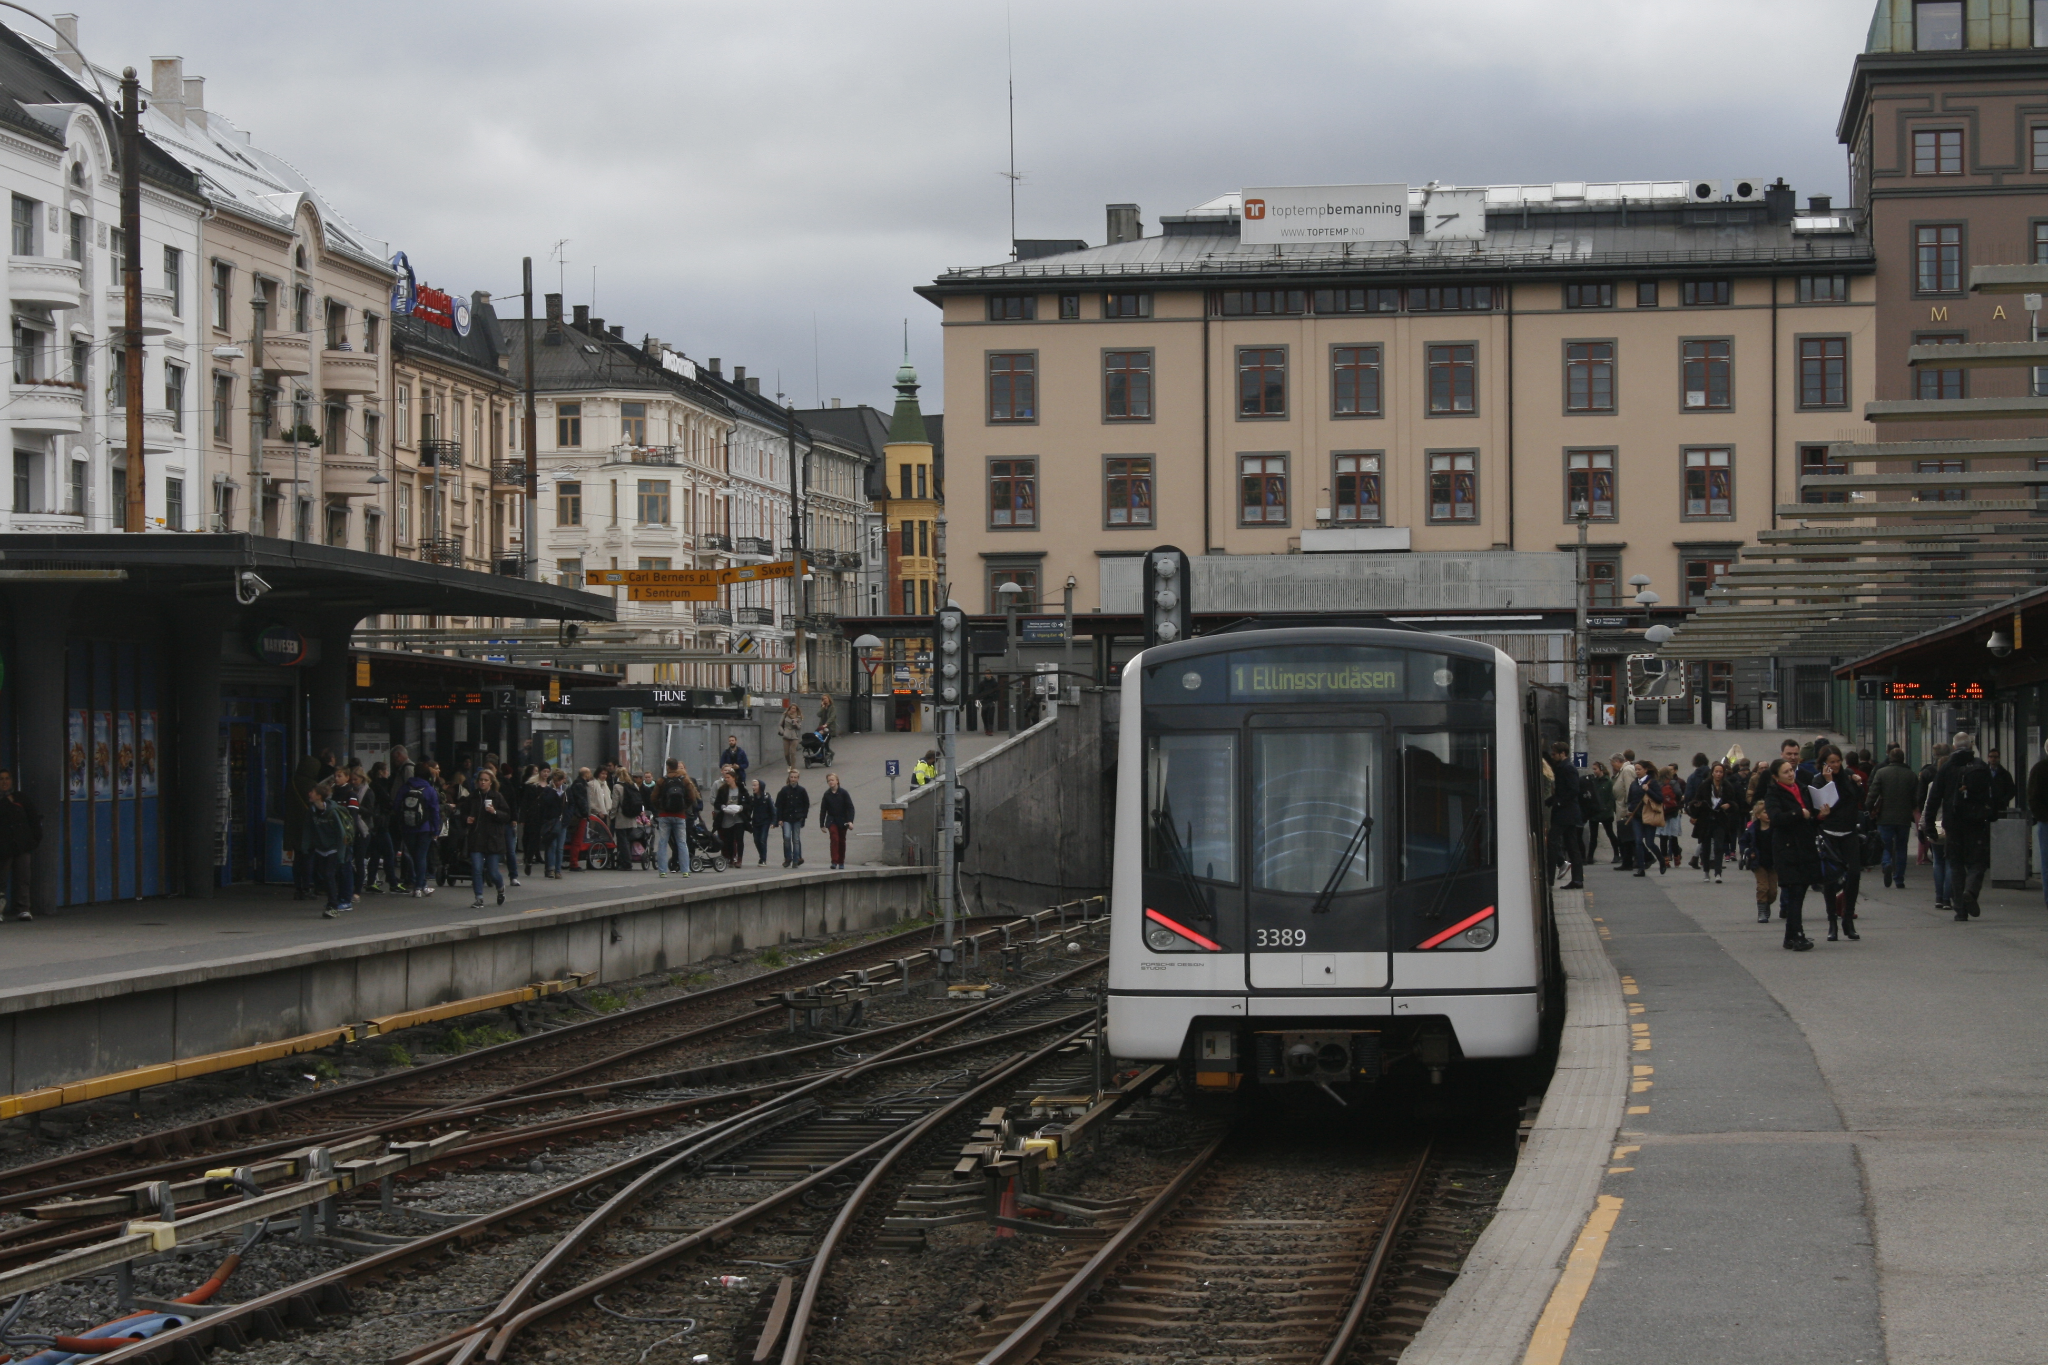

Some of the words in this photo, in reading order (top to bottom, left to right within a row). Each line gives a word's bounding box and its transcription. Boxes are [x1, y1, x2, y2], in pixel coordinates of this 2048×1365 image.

[1272, 202, 1402, 219] toptempbemanning
[1281, 228, 1365, 237] WWW.TOPTEMP.NO
[762, 565, 794, 577] Skøye
[628, 572, 652, 582] Carl
[653, 572, 695, 582] Berners
[699, 572, 711, 584] pl.
[646, 588, 691, 598] Sentrum
[263, 637, 299, 654] NARVESEN
[1235, 666, 1243, 690] 1
[1253, 665, 1395, 690] Ellingsrudåsen
[1864, 683, 1869, 694] 1
[503, 692, 511, 704] 2
[653, 690, 687, 702] THUNE
[1577, 758, 1582, 767] 1
[889, 765, 896, 775] 3
[1256, 929, 1306, 947] 3389
